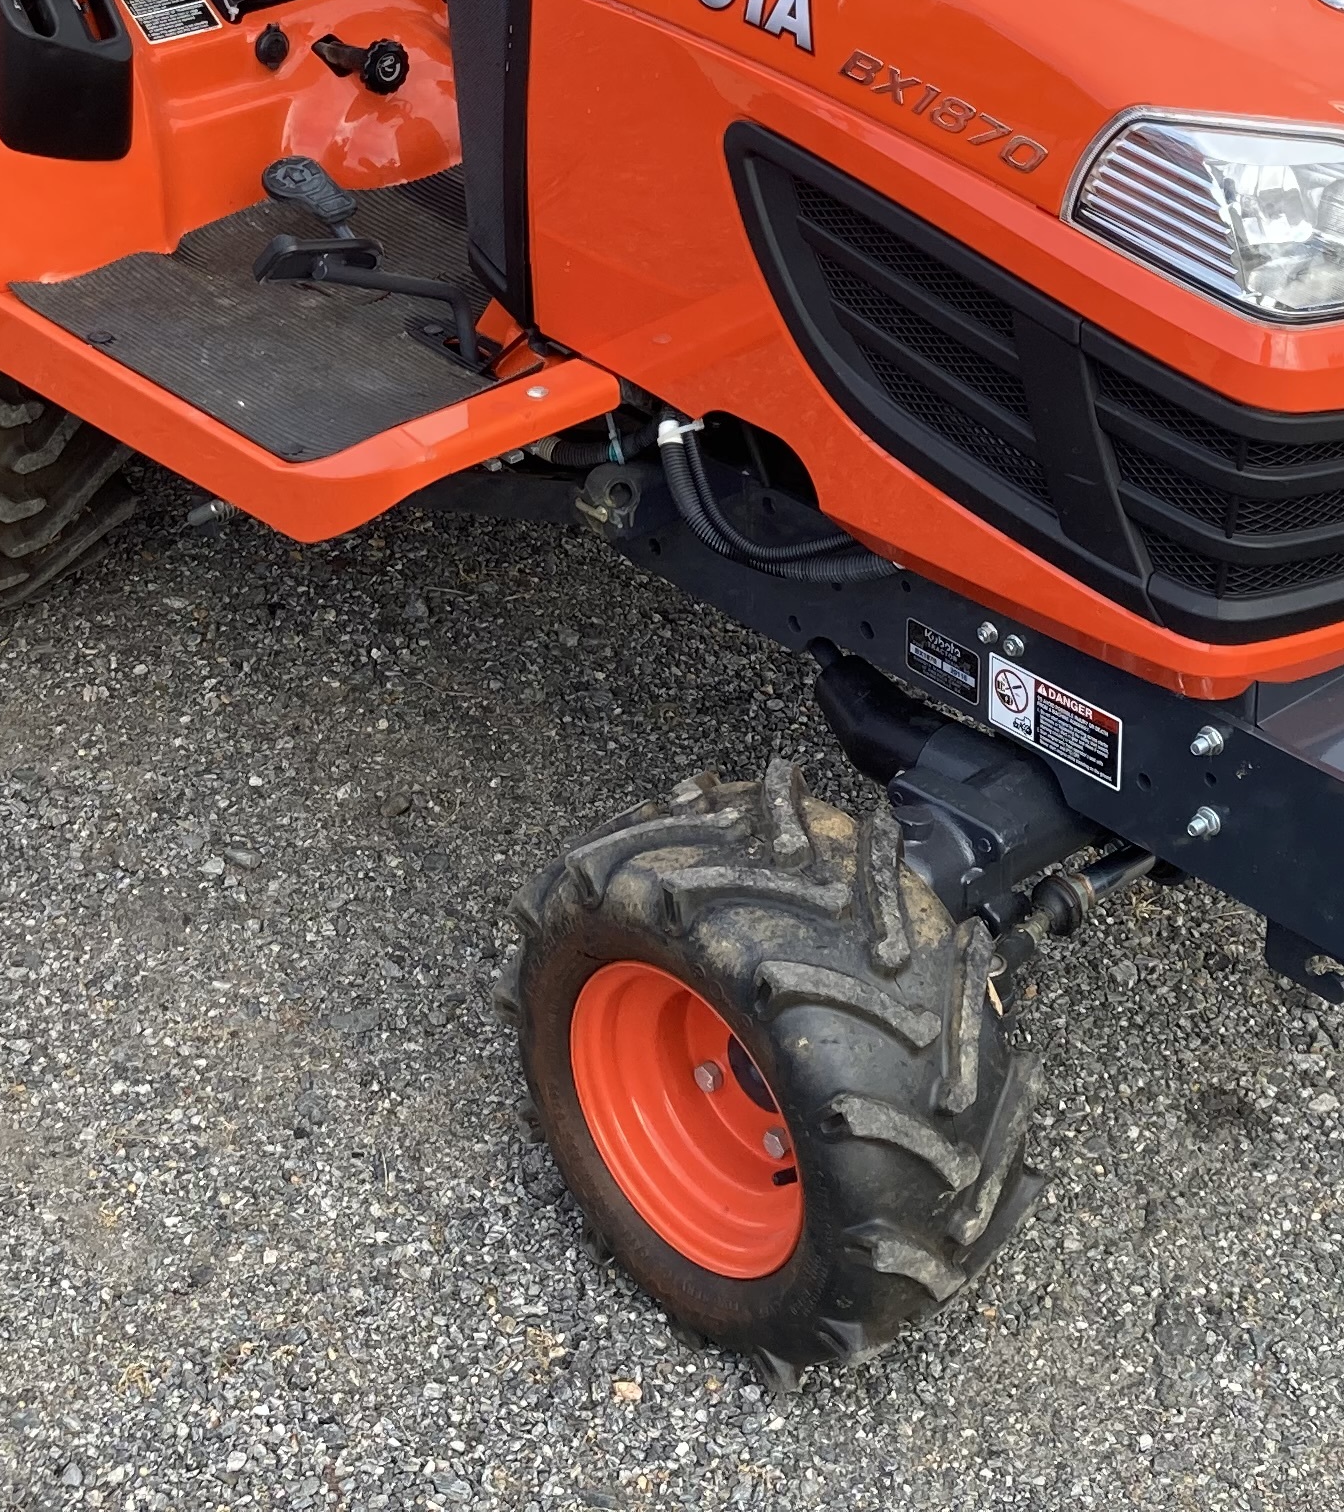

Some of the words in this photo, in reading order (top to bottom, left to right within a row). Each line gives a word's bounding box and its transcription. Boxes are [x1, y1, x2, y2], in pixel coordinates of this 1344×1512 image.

[838, 48, 1050, 174] BX1870
[924, 628, 961, 658] Kubota
[927, 640, 958, 662] TRACTOR
[1047, 687, 1094, 721] DANGER
